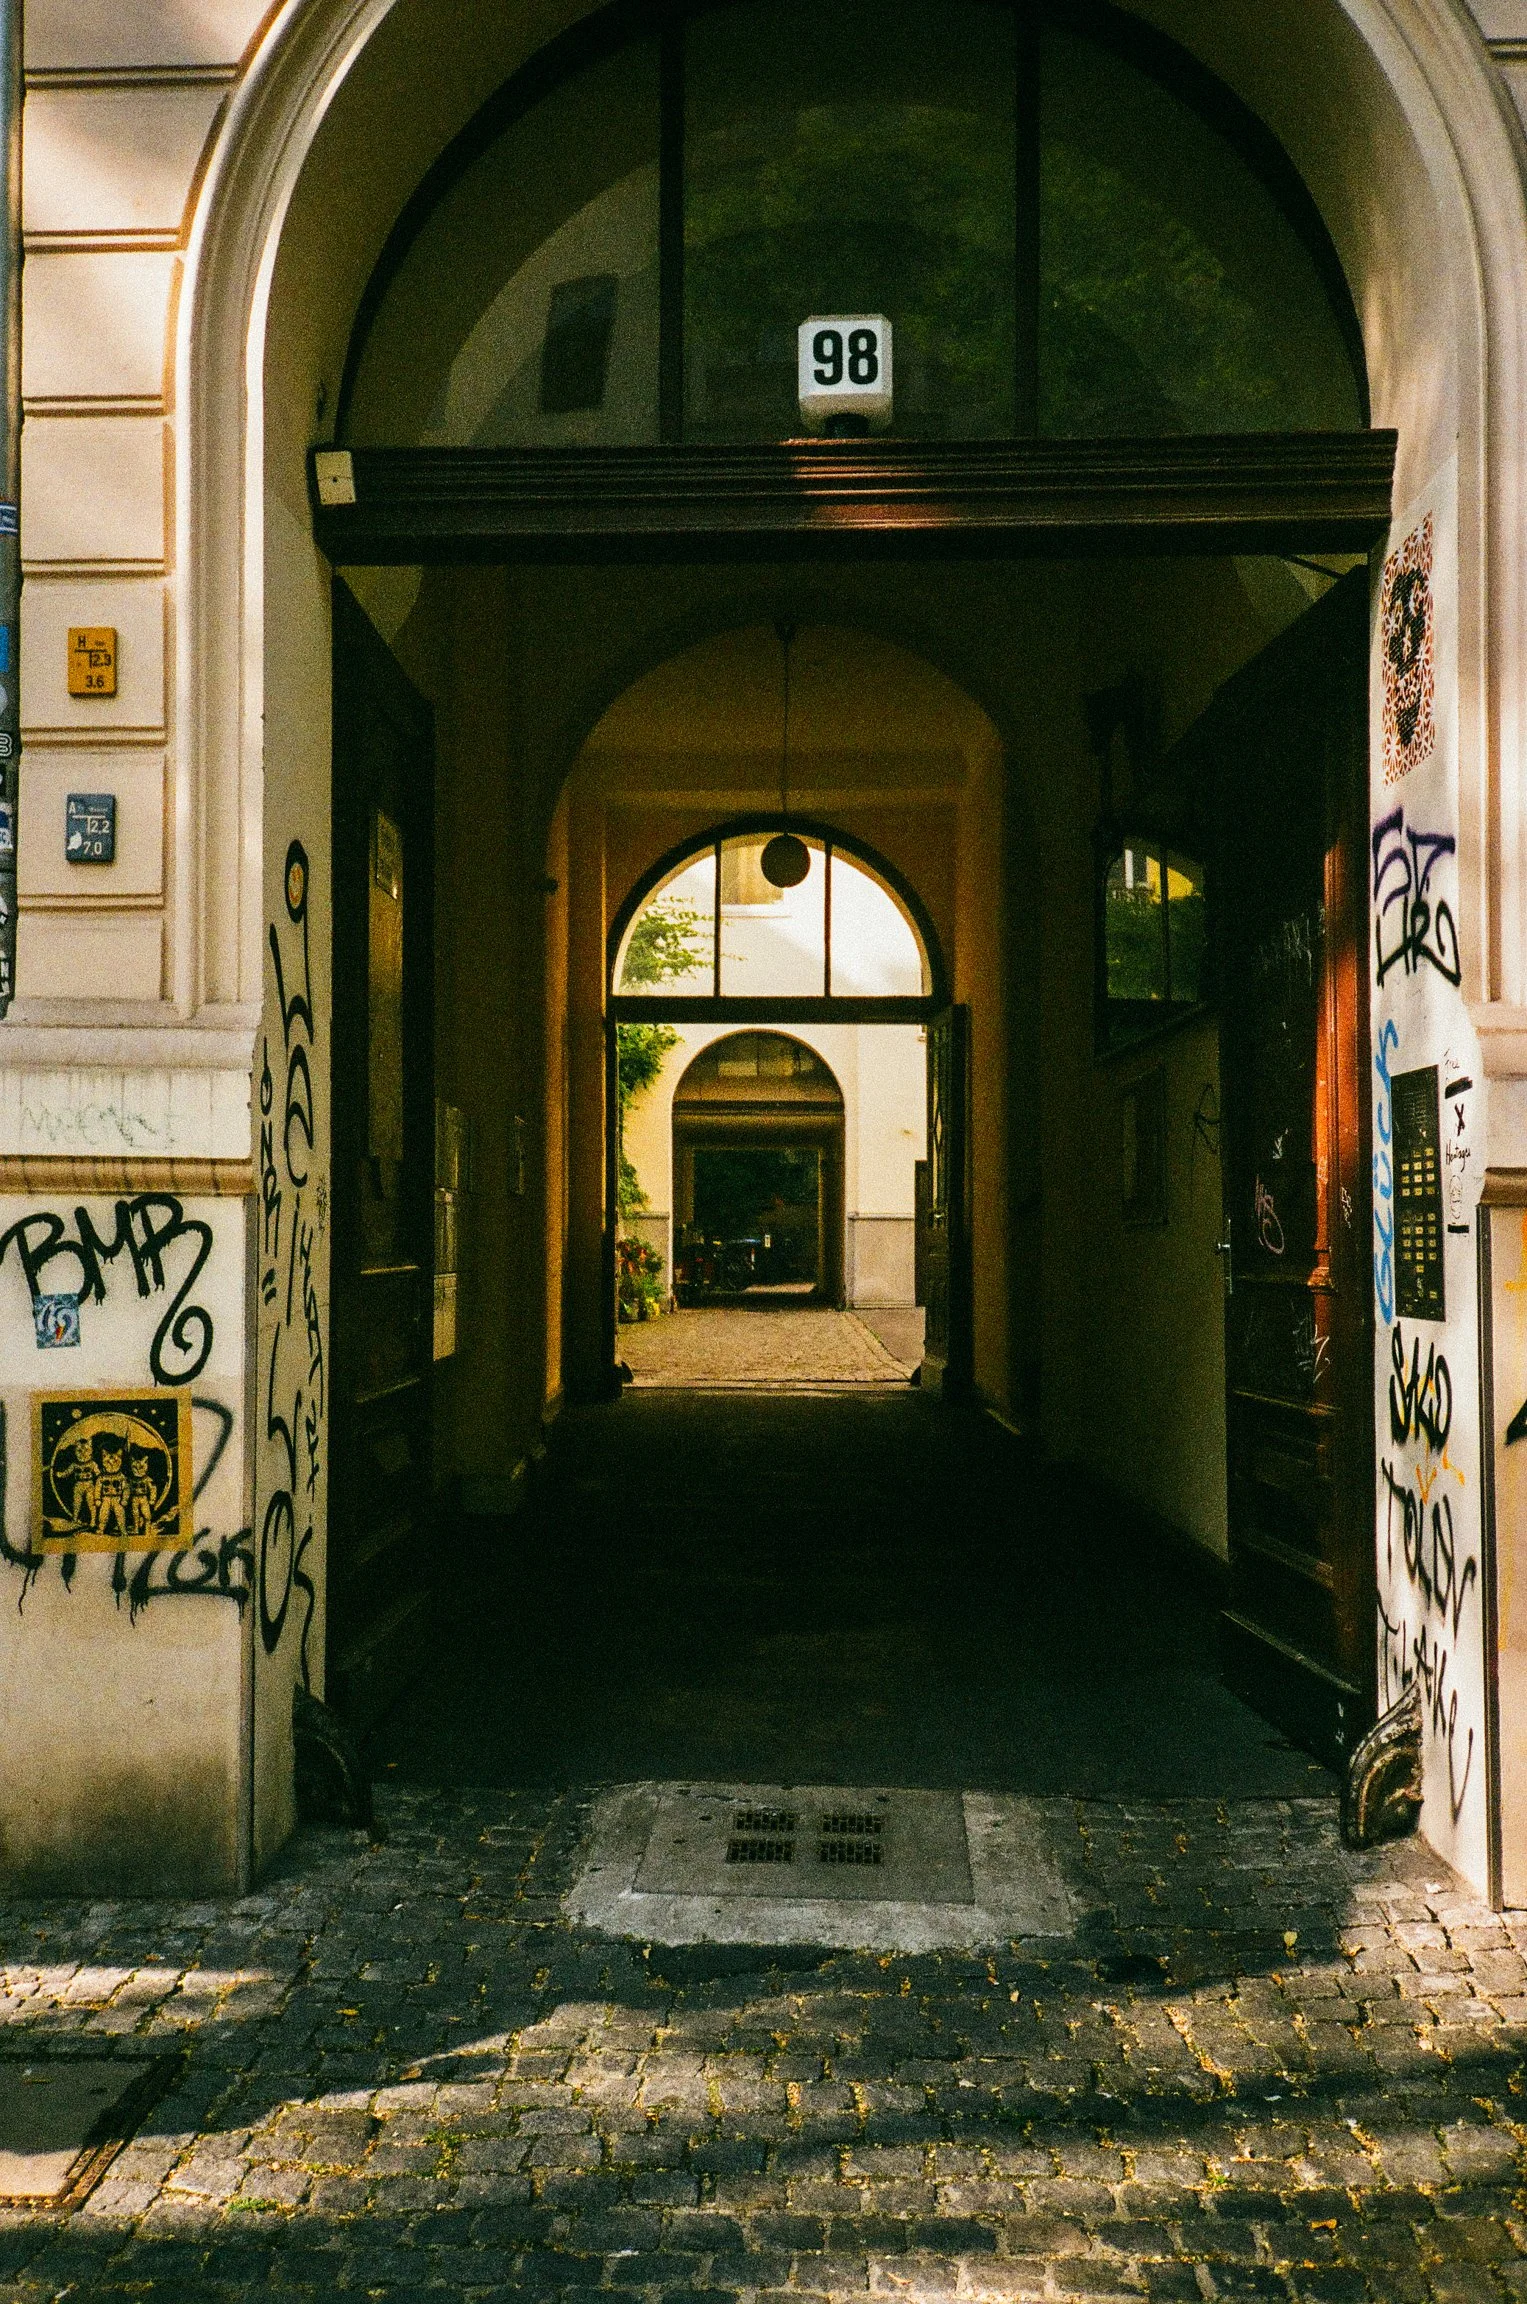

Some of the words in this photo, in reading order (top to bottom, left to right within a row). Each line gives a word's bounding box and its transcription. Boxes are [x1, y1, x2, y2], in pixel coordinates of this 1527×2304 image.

[813, 329, 878, 385] 98
[78, 635, 87, 649] H
[68, 801, 77, 814] A
